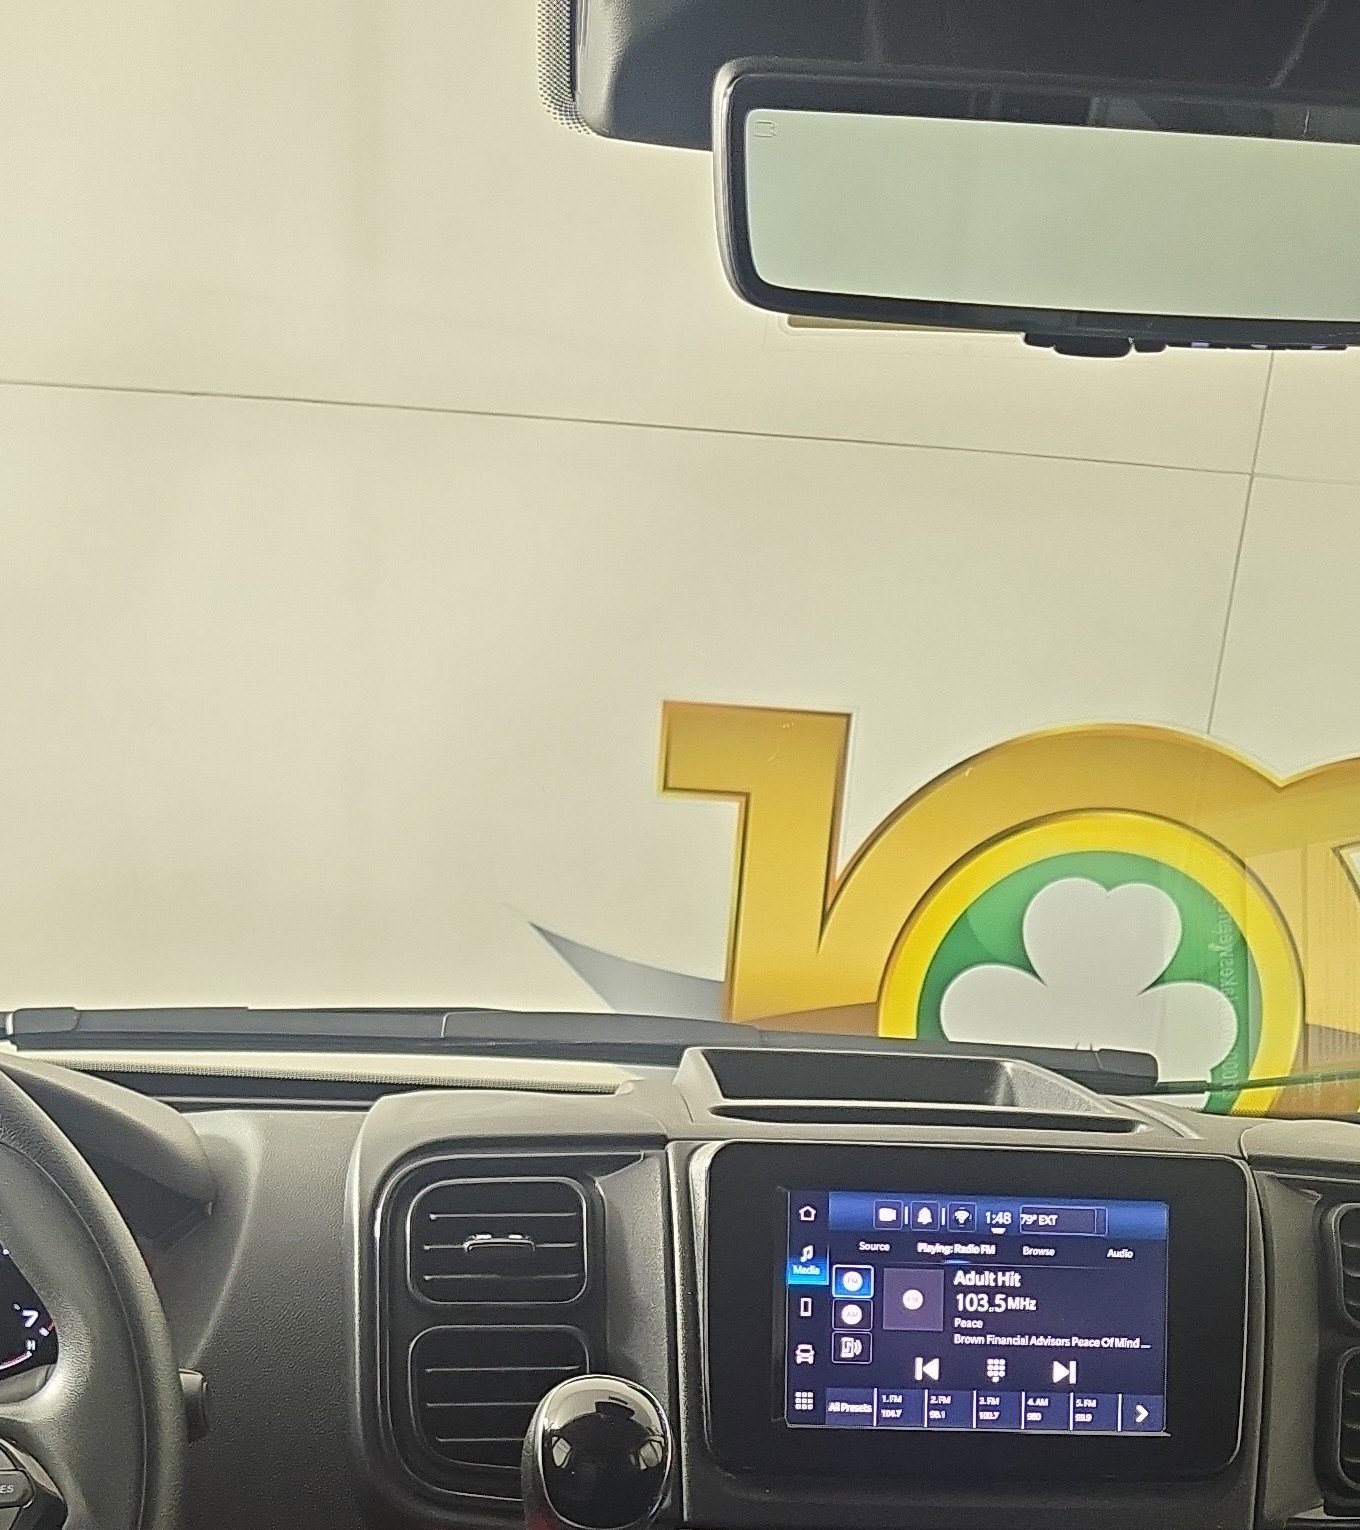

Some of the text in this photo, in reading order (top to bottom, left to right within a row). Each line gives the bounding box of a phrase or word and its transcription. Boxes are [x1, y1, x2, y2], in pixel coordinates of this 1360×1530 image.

[986, 1212, 1011, 1224] 1:48
[1039, 1215, 1058, 1225] EXT
[859, 1241, 890, 1251] Source
[917, 1242, 996, 1255] Playing: Radio FM
[1023, 1246, 1055, 1256] Browse
[1107, 1249, 1133, 1258] Audio
[793, 1266, 820, 1275] Media
[954, 1270, 1021, 1287] Adult Hit
[956, 1294, 1036, 1313] 103.5 MHz
[22, 1310, 38, 1327] 7
[955, 1318, 983, 1329] Peace
[954, 1334, 984, 1345] Brown
[986, 1334, 1028, 1346] Financial
[1030, 1336, 1070, 1347] Advisors
[1072, 1338, 1100, 1347] Peace
[1101, 1338, 1114, 1348] Of
[1115, 1339, 1140, 1349] Mind
[841, 1403, 872, 1412] Presets
